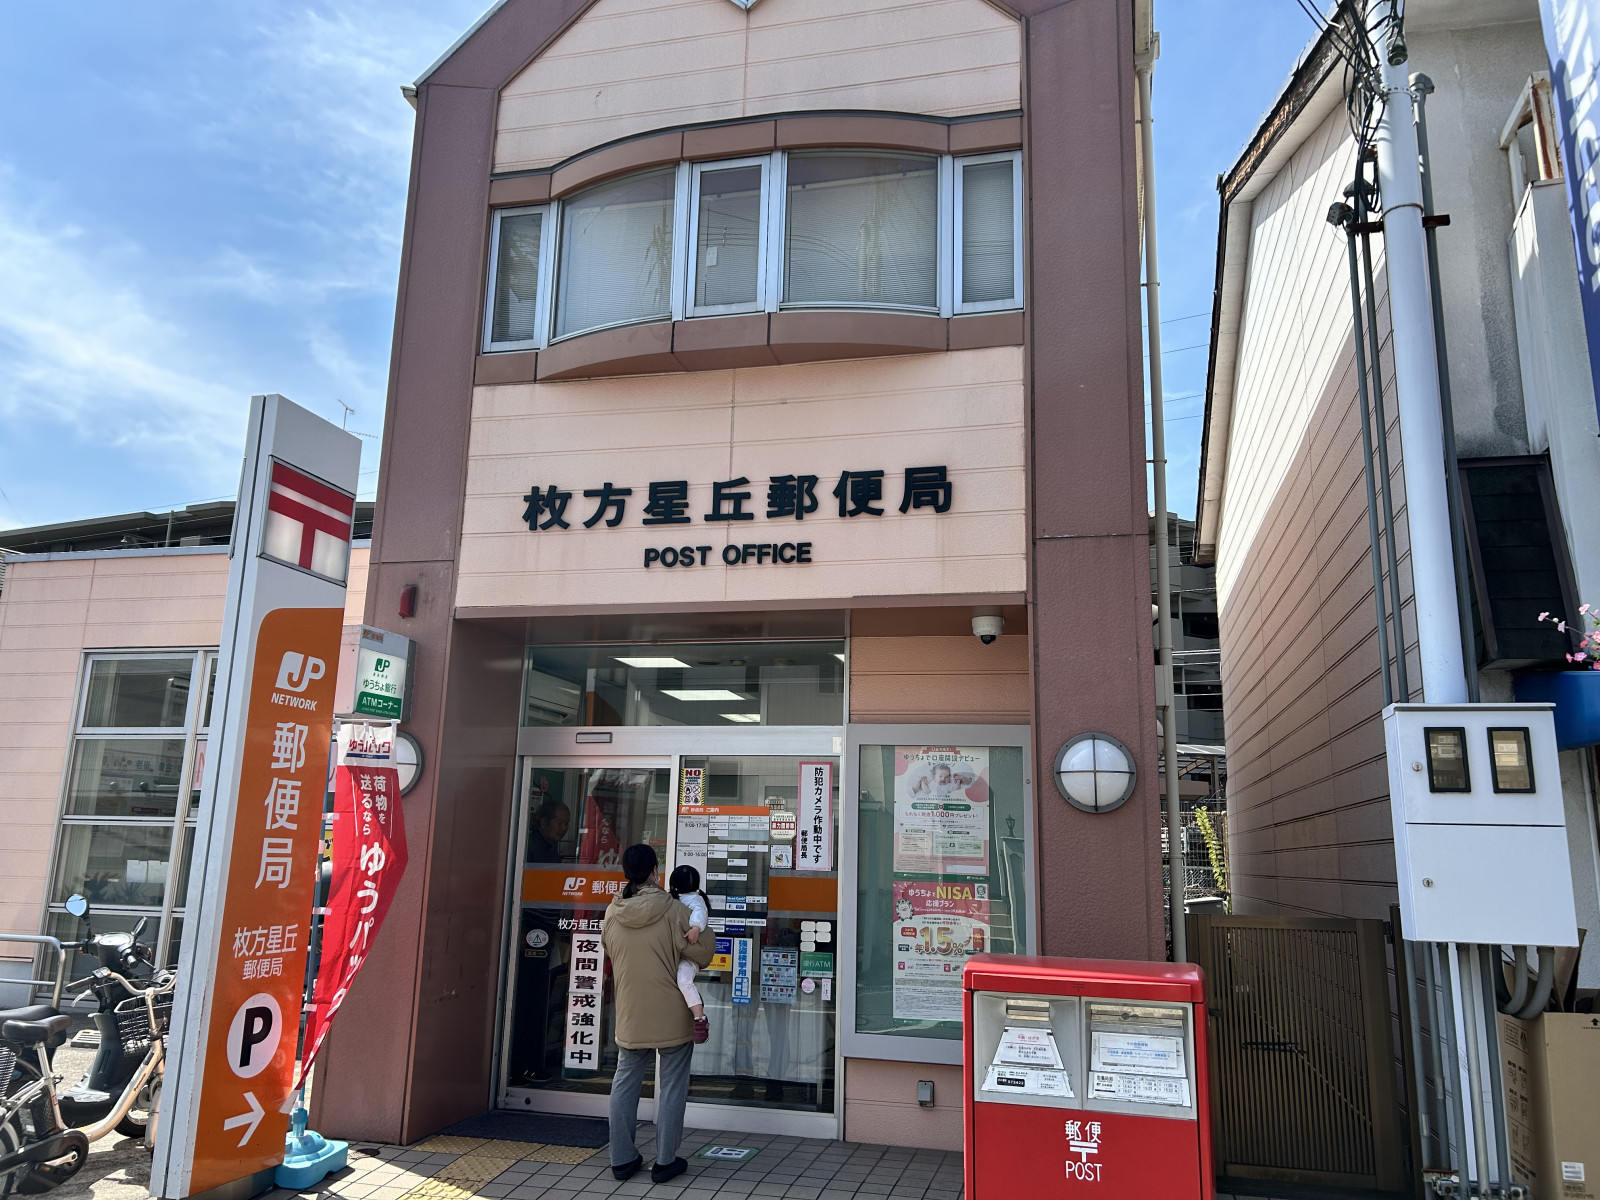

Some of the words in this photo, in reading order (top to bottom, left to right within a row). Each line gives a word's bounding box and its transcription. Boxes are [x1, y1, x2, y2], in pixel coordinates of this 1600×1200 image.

[522, 465, 953, 531] 枚方星丘郵便局
[644, 546, 712, 568] POST
[722, 542, 812, 566] OFFICE
[275, 651, 326, 692] JP
[375, 658, 390, 672] JP
[363, 678, 397, 695] ゆうちょ銀行
[271, 693, 318, 711] NETWORK
[361, 697, 399, 709] ATMコーナー
[903, 754, 980, 762] ゆうちょで口座開設デビュー
[685, 769, 702, 777] NO
[254, 721, 309, 890] 郵便局
[359, 774, 373, 835] 送るなら
[373, 775, 387, 825] 荷物を
[812, 767, 824, 864] 防犯カメラ作動中です
[563, 877, 587, 891] JP
[925, 900, 955, 908] 応援プラン
[233, 923, 299, 959] 枚方星丘
[242, 958, 283, 980] 郵便局
[570, 939, 599, 1064] 夜間警戒強化中
[239, 1006, 273, 1069] P
[1064, 1120, 1102, 1144] 郵便
[1065, 1160, 1102, 1182] POST
